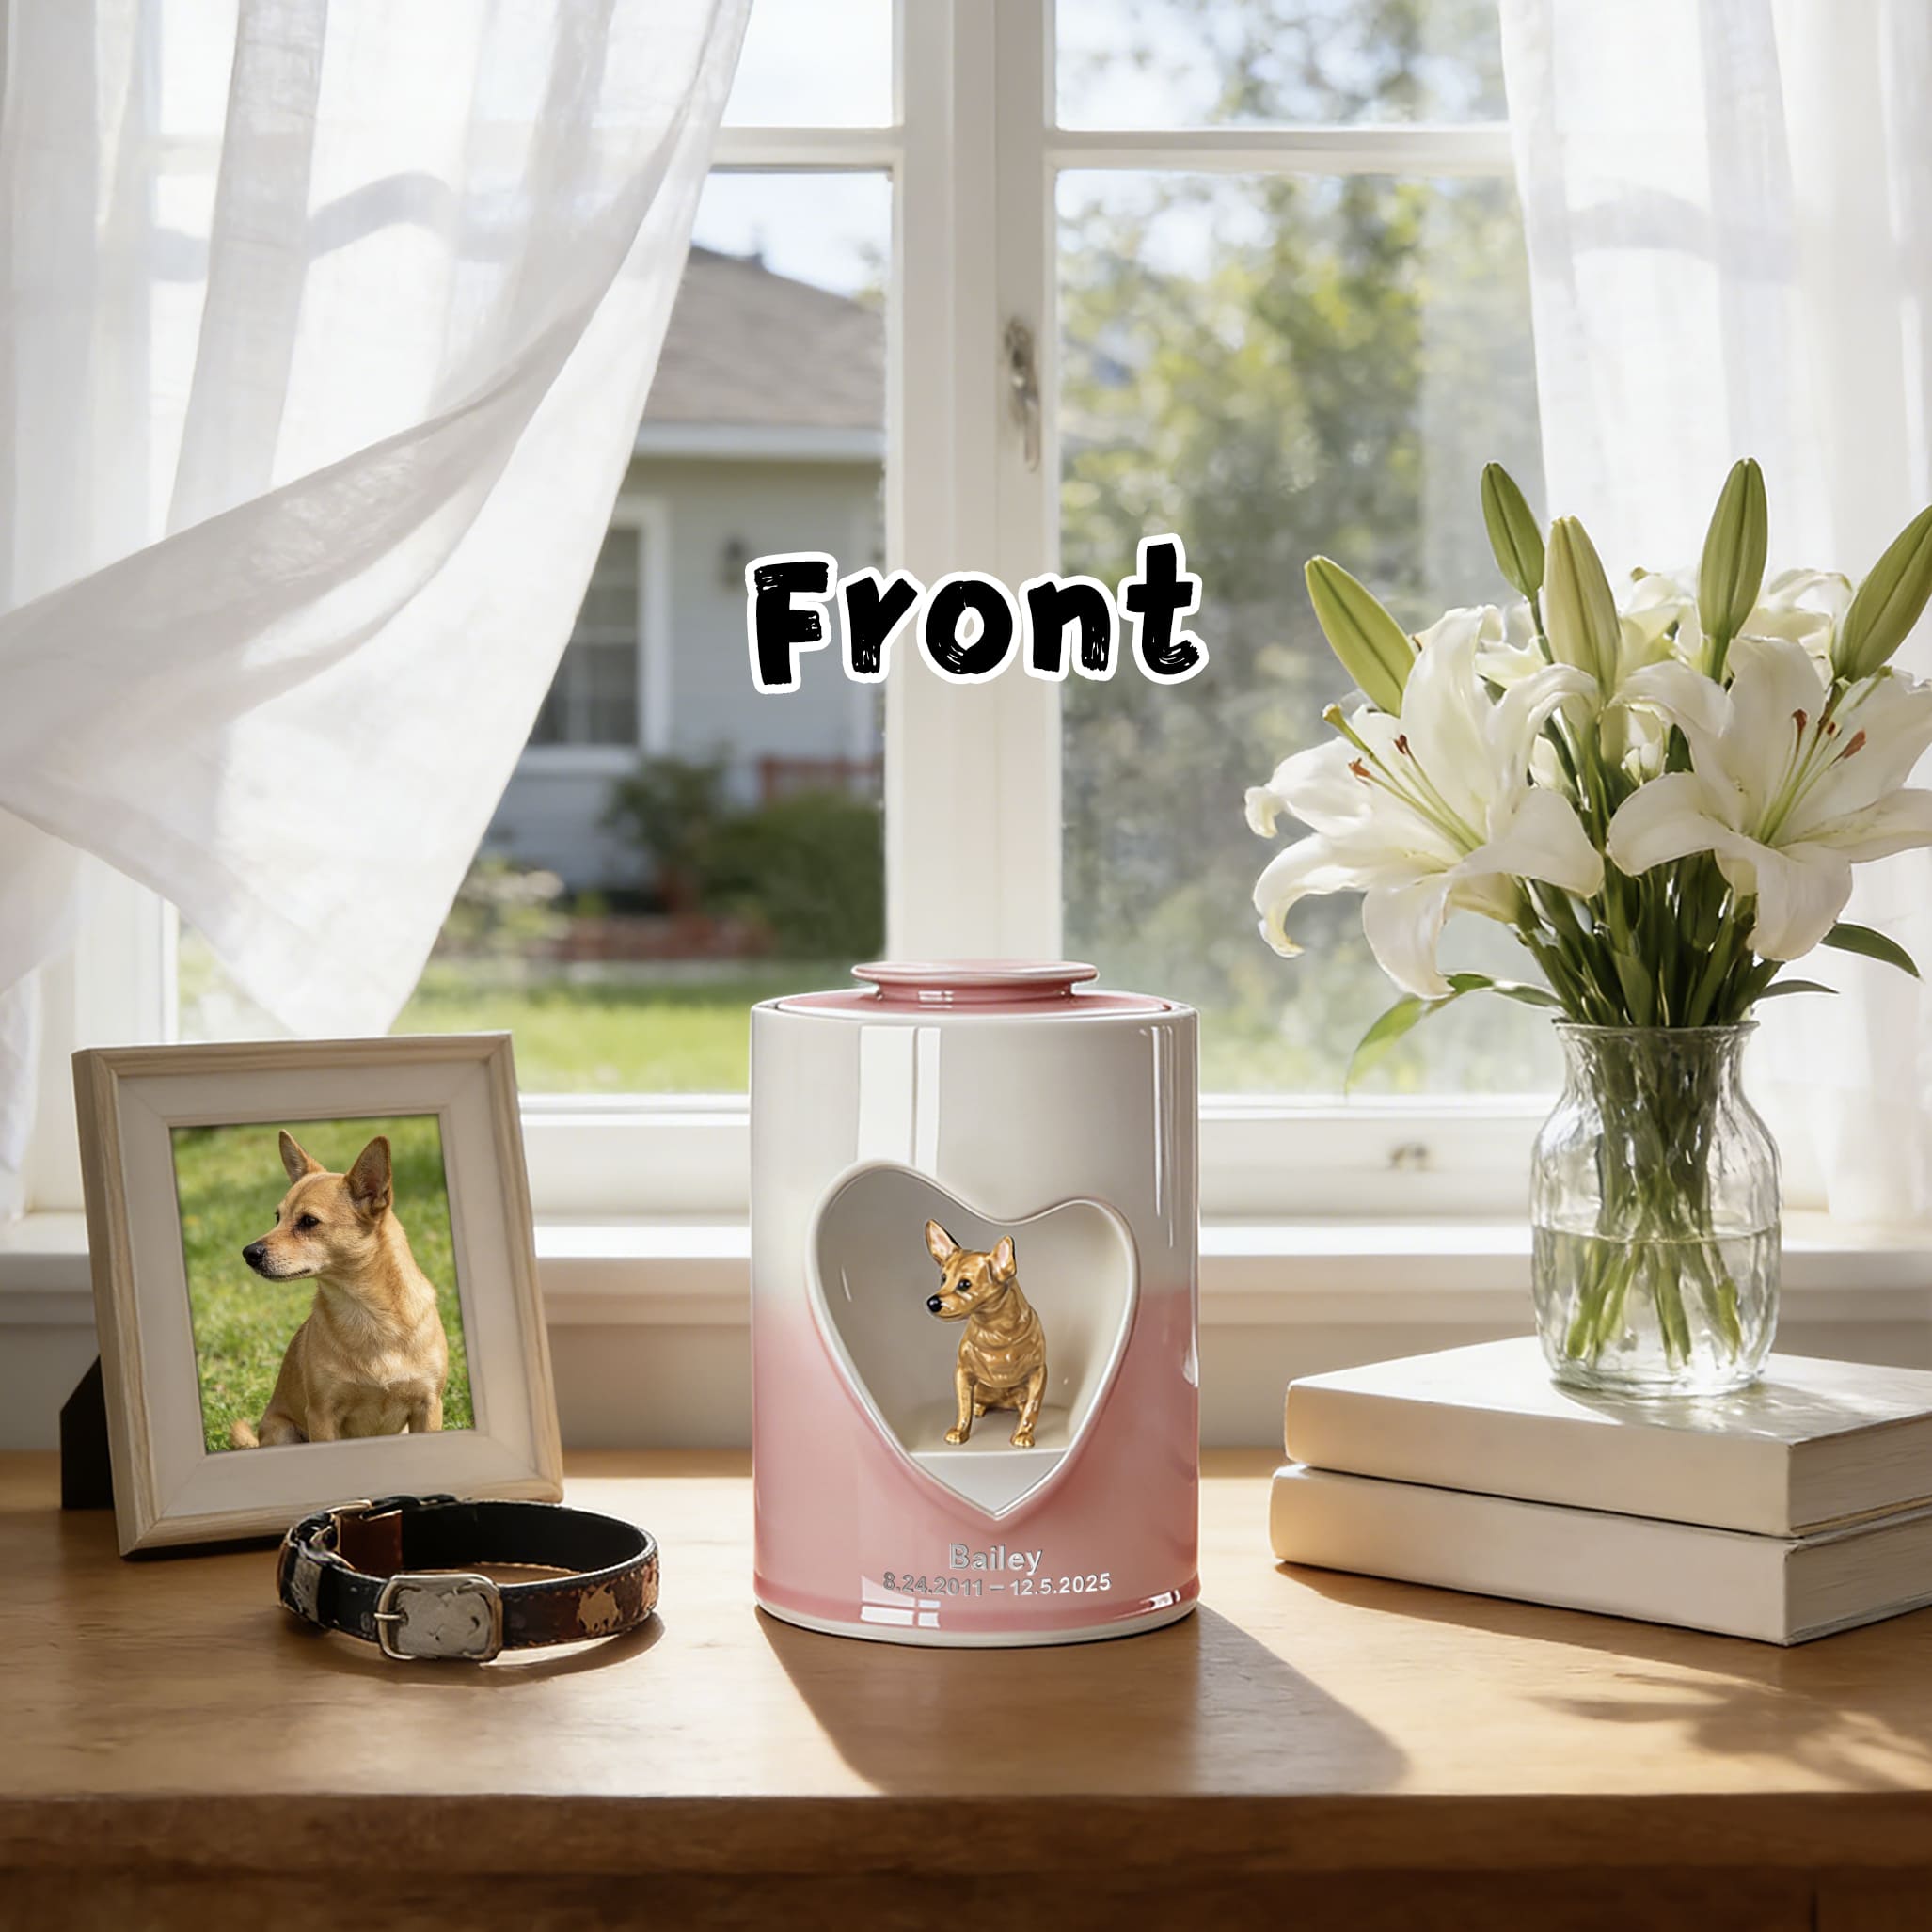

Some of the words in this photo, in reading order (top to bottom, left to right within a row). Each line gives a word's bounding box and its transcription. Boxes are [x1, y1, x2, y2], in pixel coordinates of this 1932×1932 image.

[949, 1543, 1042, 1576] Bailey
[882, 1572, 983, 1596] 8.24.2011
[1009, 1572, 1113, 1596] 12.5.2025
